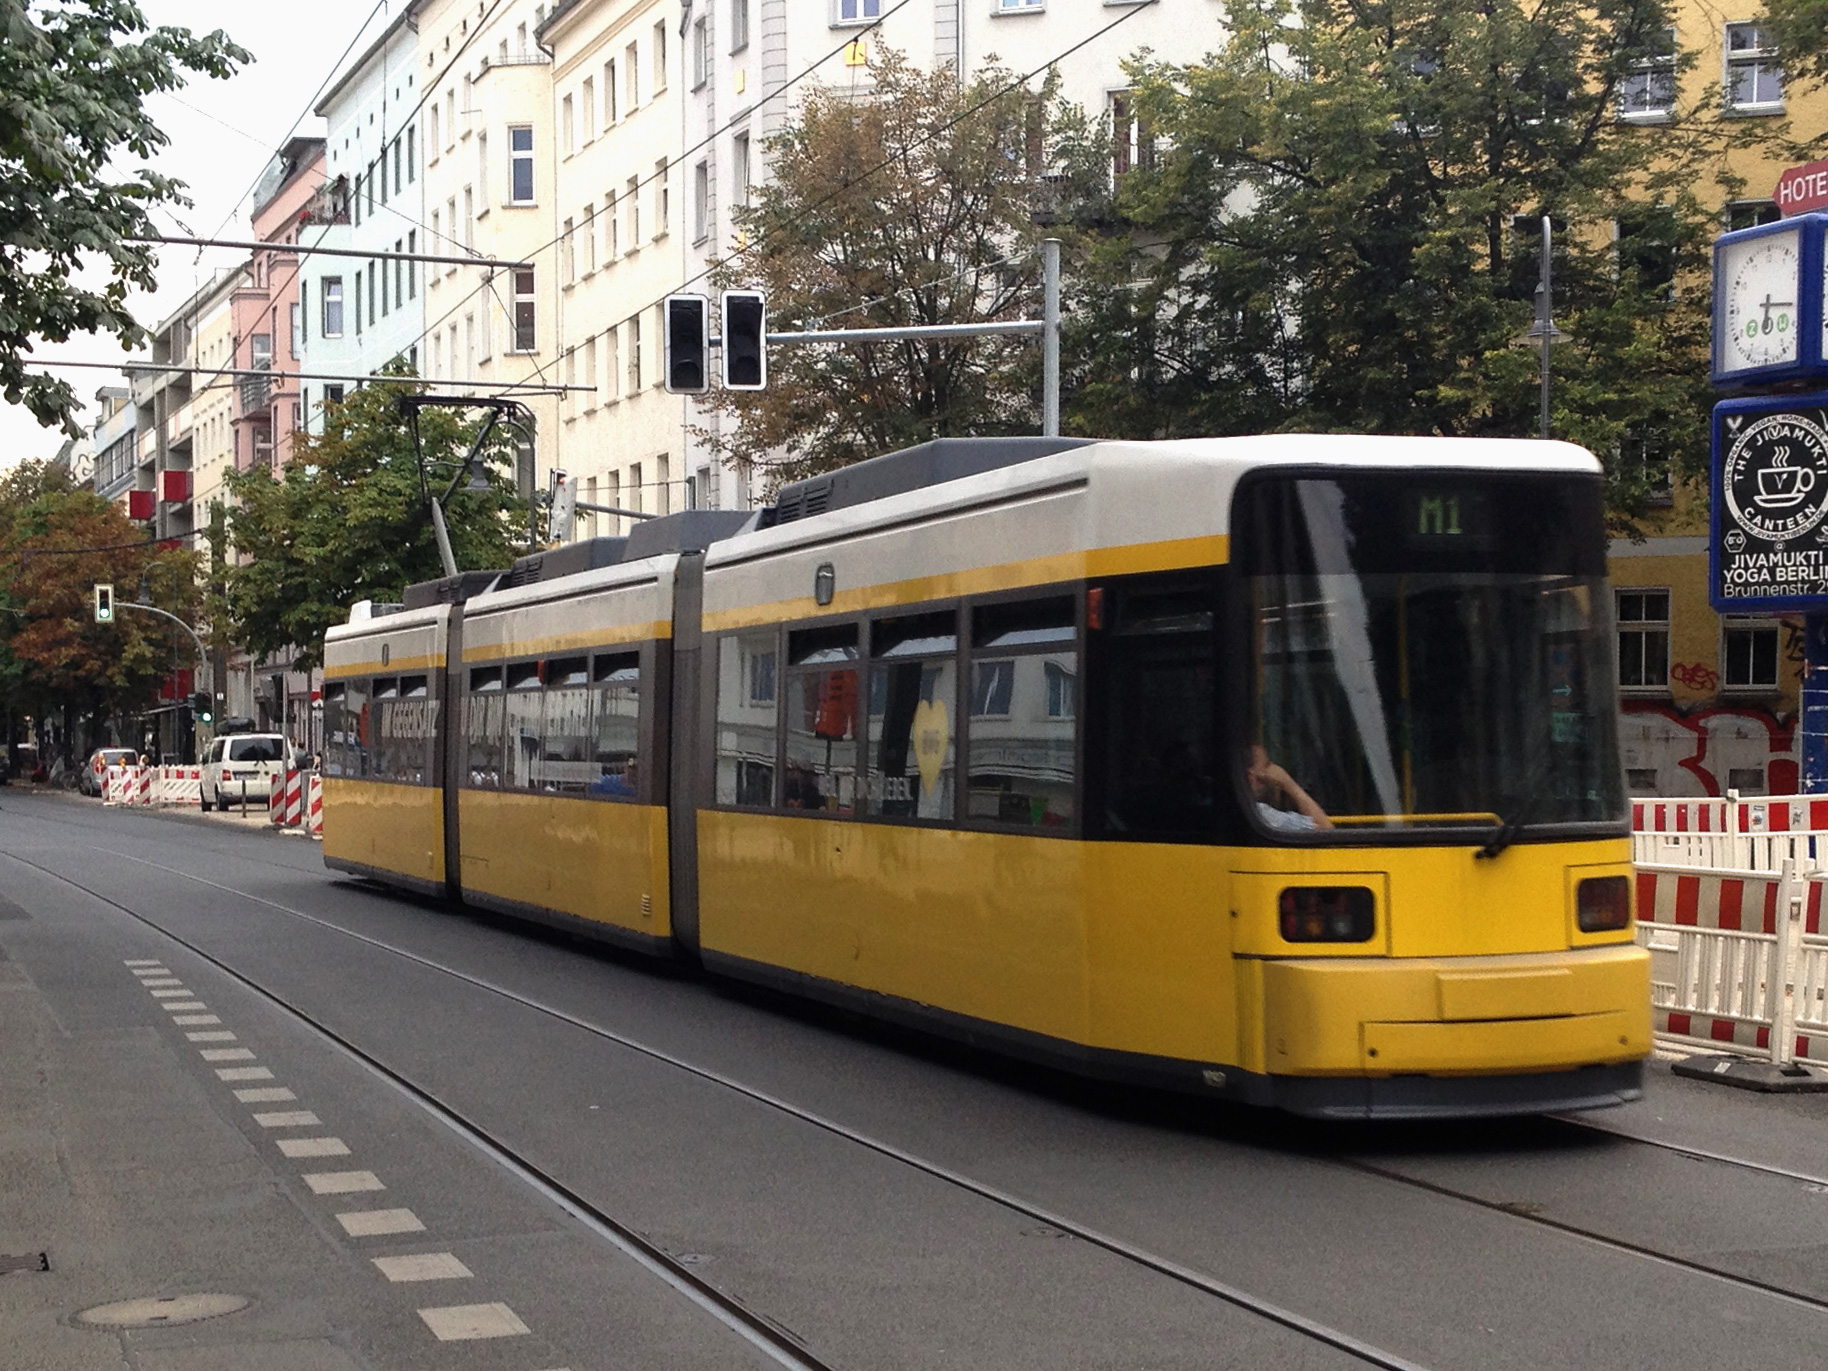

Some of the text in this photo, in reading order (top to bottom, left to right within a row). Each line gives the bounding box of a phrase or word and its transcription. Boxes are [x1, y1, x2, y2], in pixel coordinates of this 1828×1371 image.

[1734, 424, 1827, 482] THE JIVAMUKTI
[1419, 498, 1462, 534] M1
[1744, 503, 1817, 531] CANTEEN
[1731, 550, 1824, 569] JIVAMUKTI
[1723, 566, 1772, 584] YOGA
[1724, 580, 1828, 598] Brunnenstr. 2
